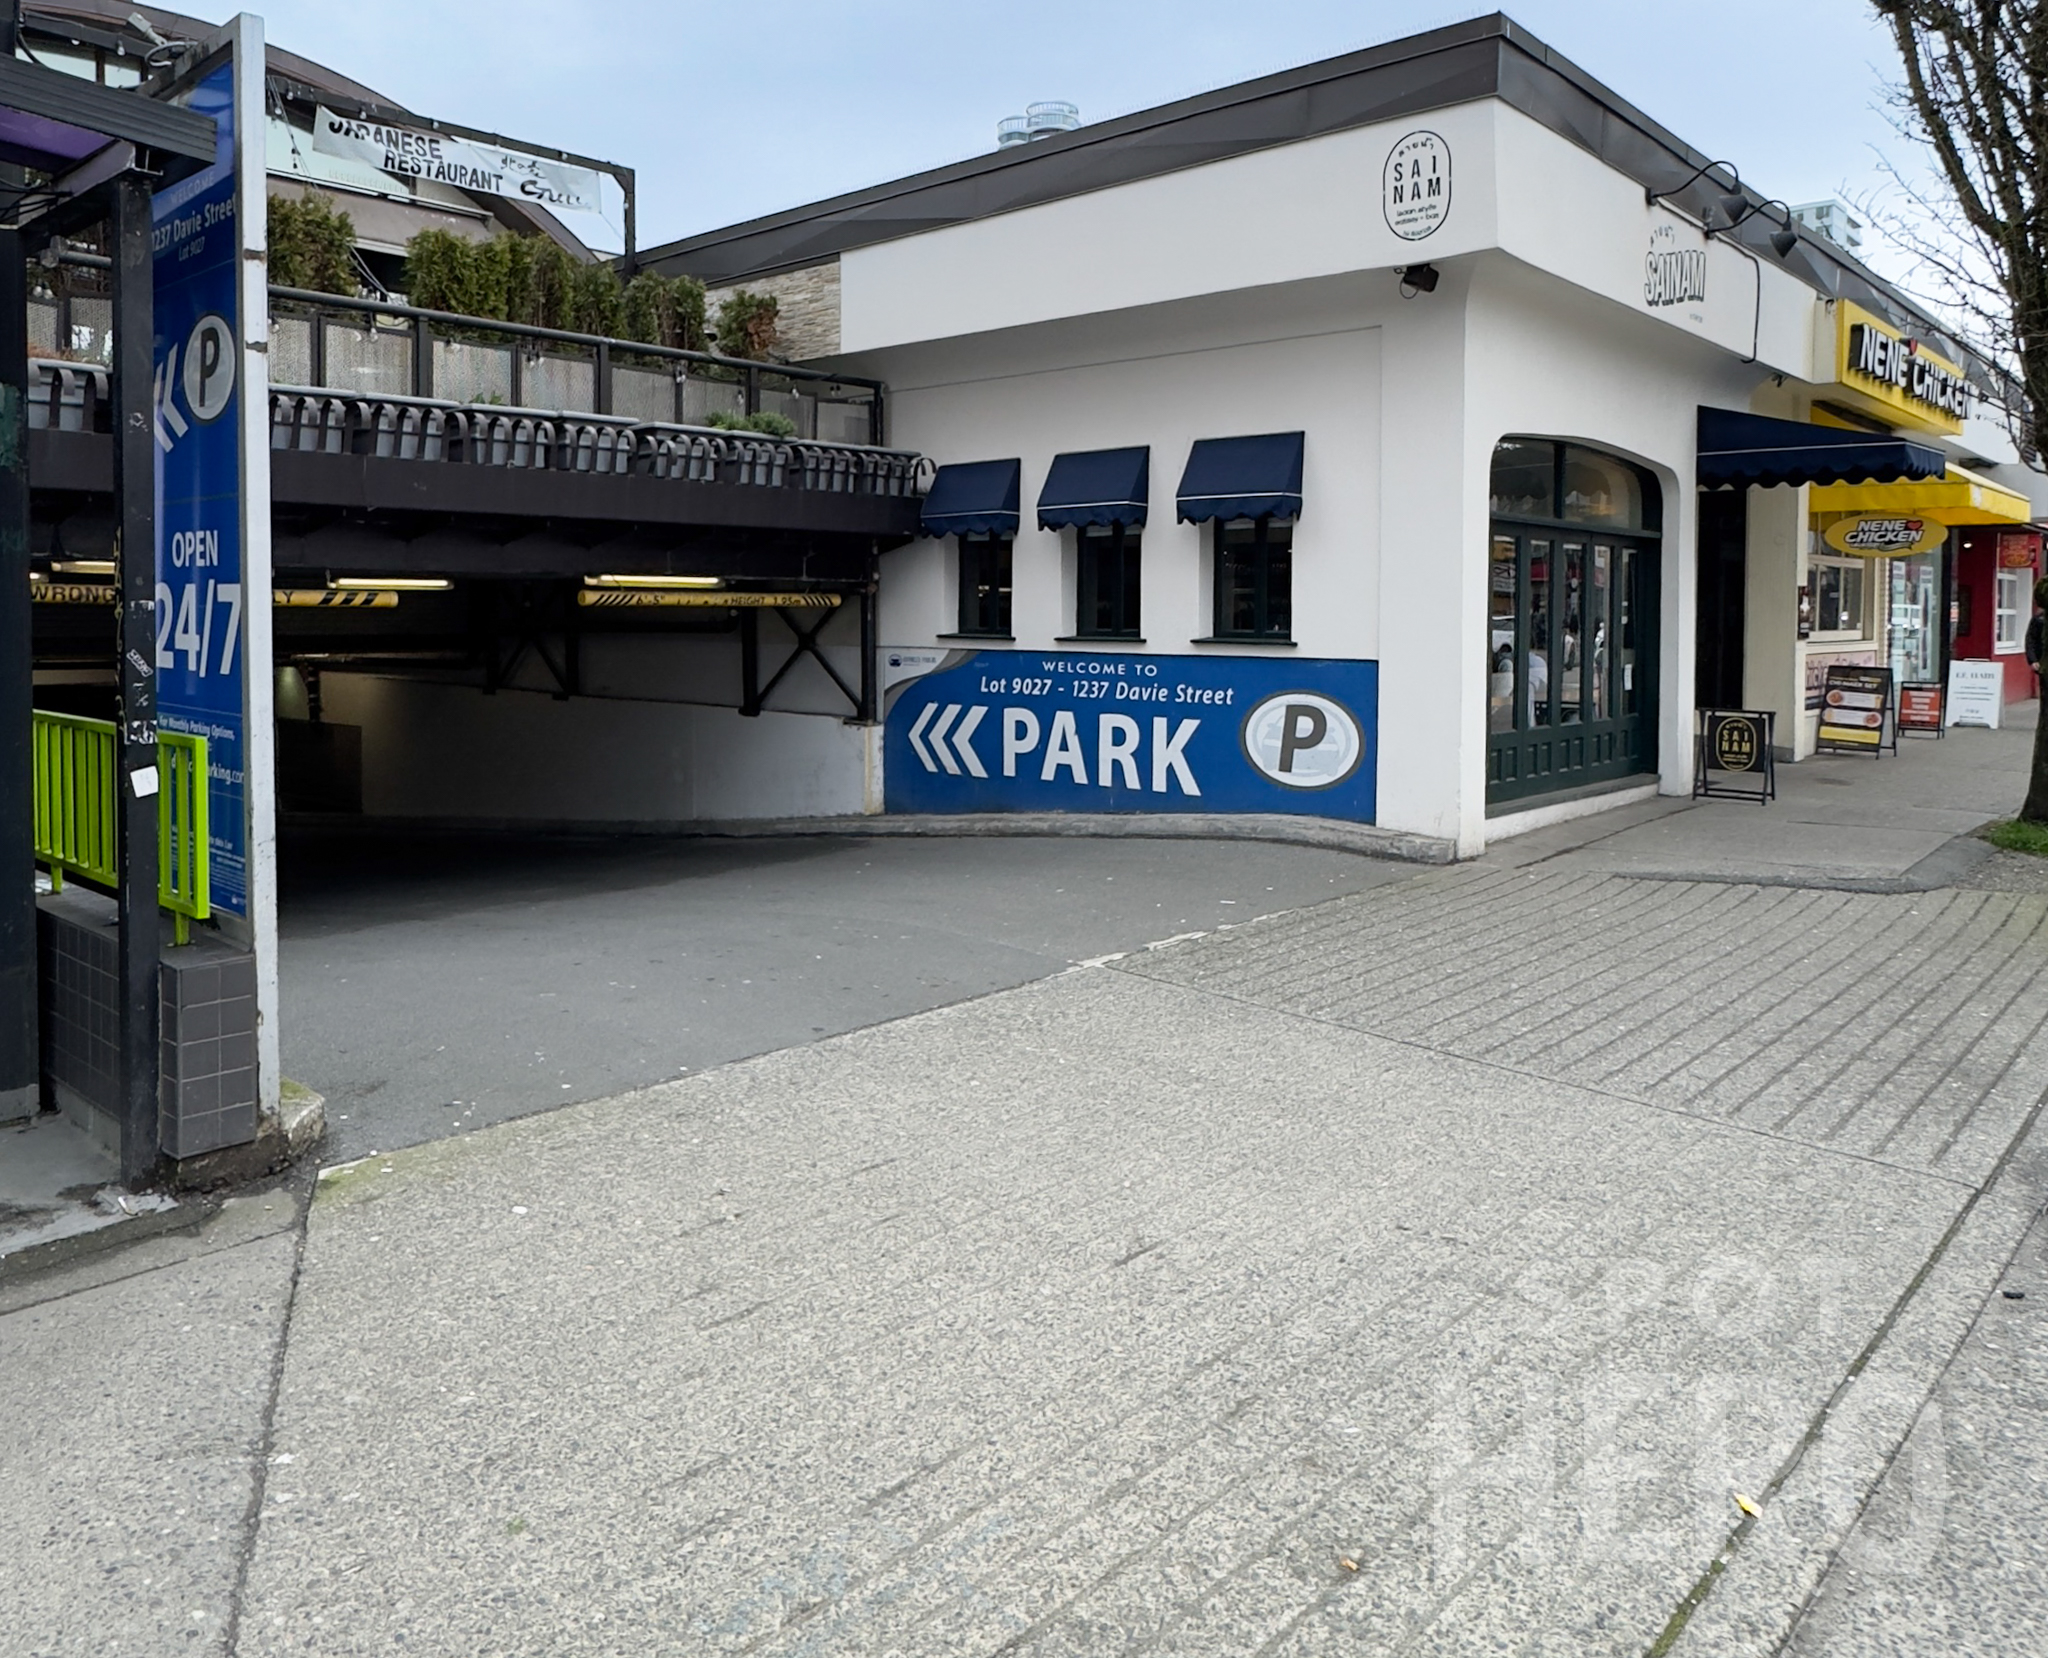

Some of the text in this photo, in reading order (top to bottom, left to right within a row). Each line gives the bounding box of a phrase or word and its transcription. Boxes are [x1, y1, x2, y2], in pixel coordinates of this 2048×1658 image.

[328, 119, 443, 159] JAPANESE
[384, 151, 503, 193] RESTAURANT
[1394, 155, 1437, 182] SAI
[171, 171, 215, 204] WELCOME
[1393, 177, 1441, 204] NAM
[173, 210, 202, 242] Davie
[204, 193, 236, 228] Street
[179, 245, 189, 261] Lot
[199, 327, 220, 407] P
[1858, 323, 1974, 420] NENE CHICKEN
[1844, 530, 1923, 543] CHICKEN
[1857, 520, 1907, 531] NENE
[172, 530, 218, 567] OPEN
[31, 585, 116, 602] WRONG
[730, 596, 766, 606] HEIGHT
[156, 579, 242, 678] 24/7
[1042, 661, 1158, 676] WELCOME TO
[980, 676, 1006, 693] Lot
[1012, 678, 1052, 695] 9027
[1073, 680, 1109, 698] 1237
[1115, 682, 1168, 701] Davie
[1175, 684, 1234, 705] Street
[190, 721, 210, 737] Parking
[1278, 704, 1327, 773] P
[1722, 730, 1749, 741] SAI
[1003, 707, 1201, 796] PARK
